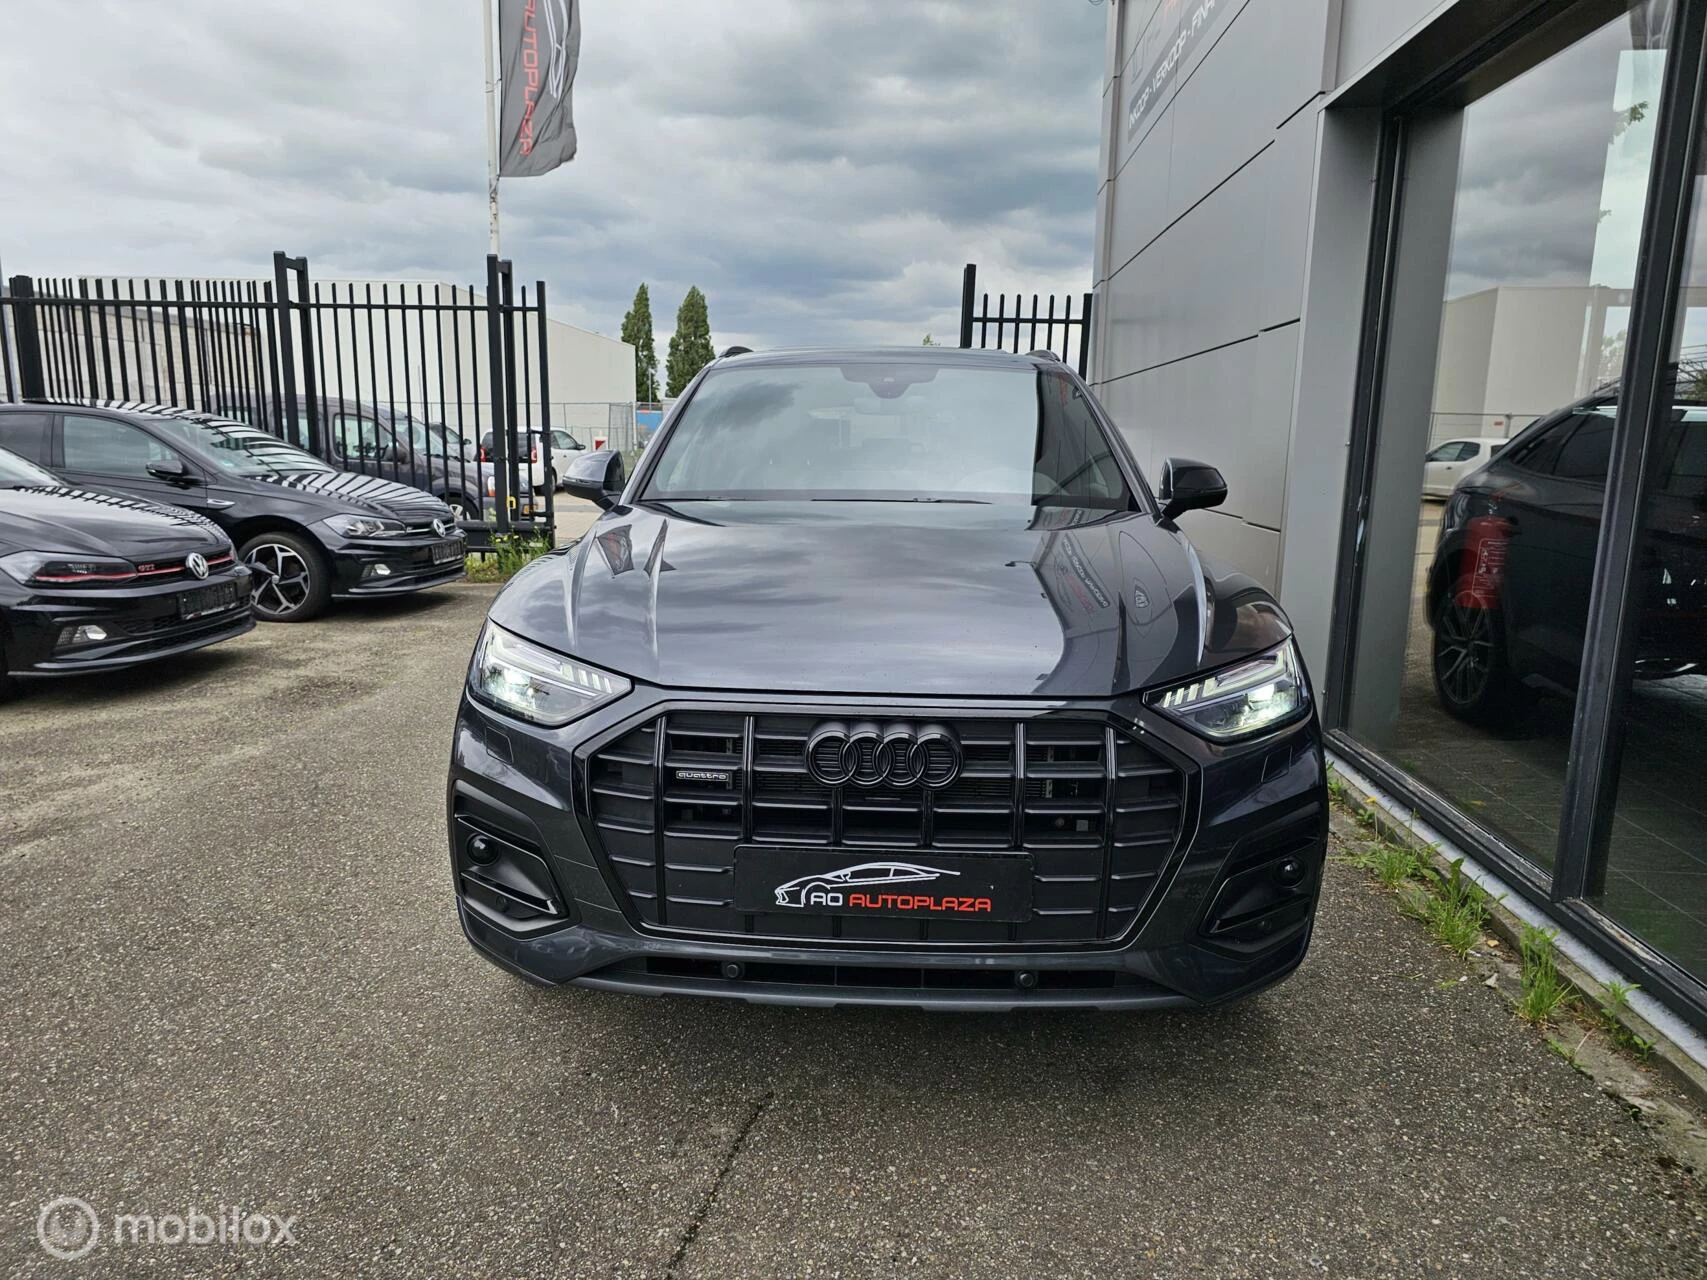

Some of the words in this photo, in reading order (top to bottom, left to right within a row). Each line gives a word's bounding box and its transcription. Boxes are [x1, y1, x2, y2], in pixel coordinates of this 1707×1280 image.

[678, 771, 727, 781] quattro
[810, 892, 843, 906] AO
[848, 893, 992, 912] AUTOPLAZA
